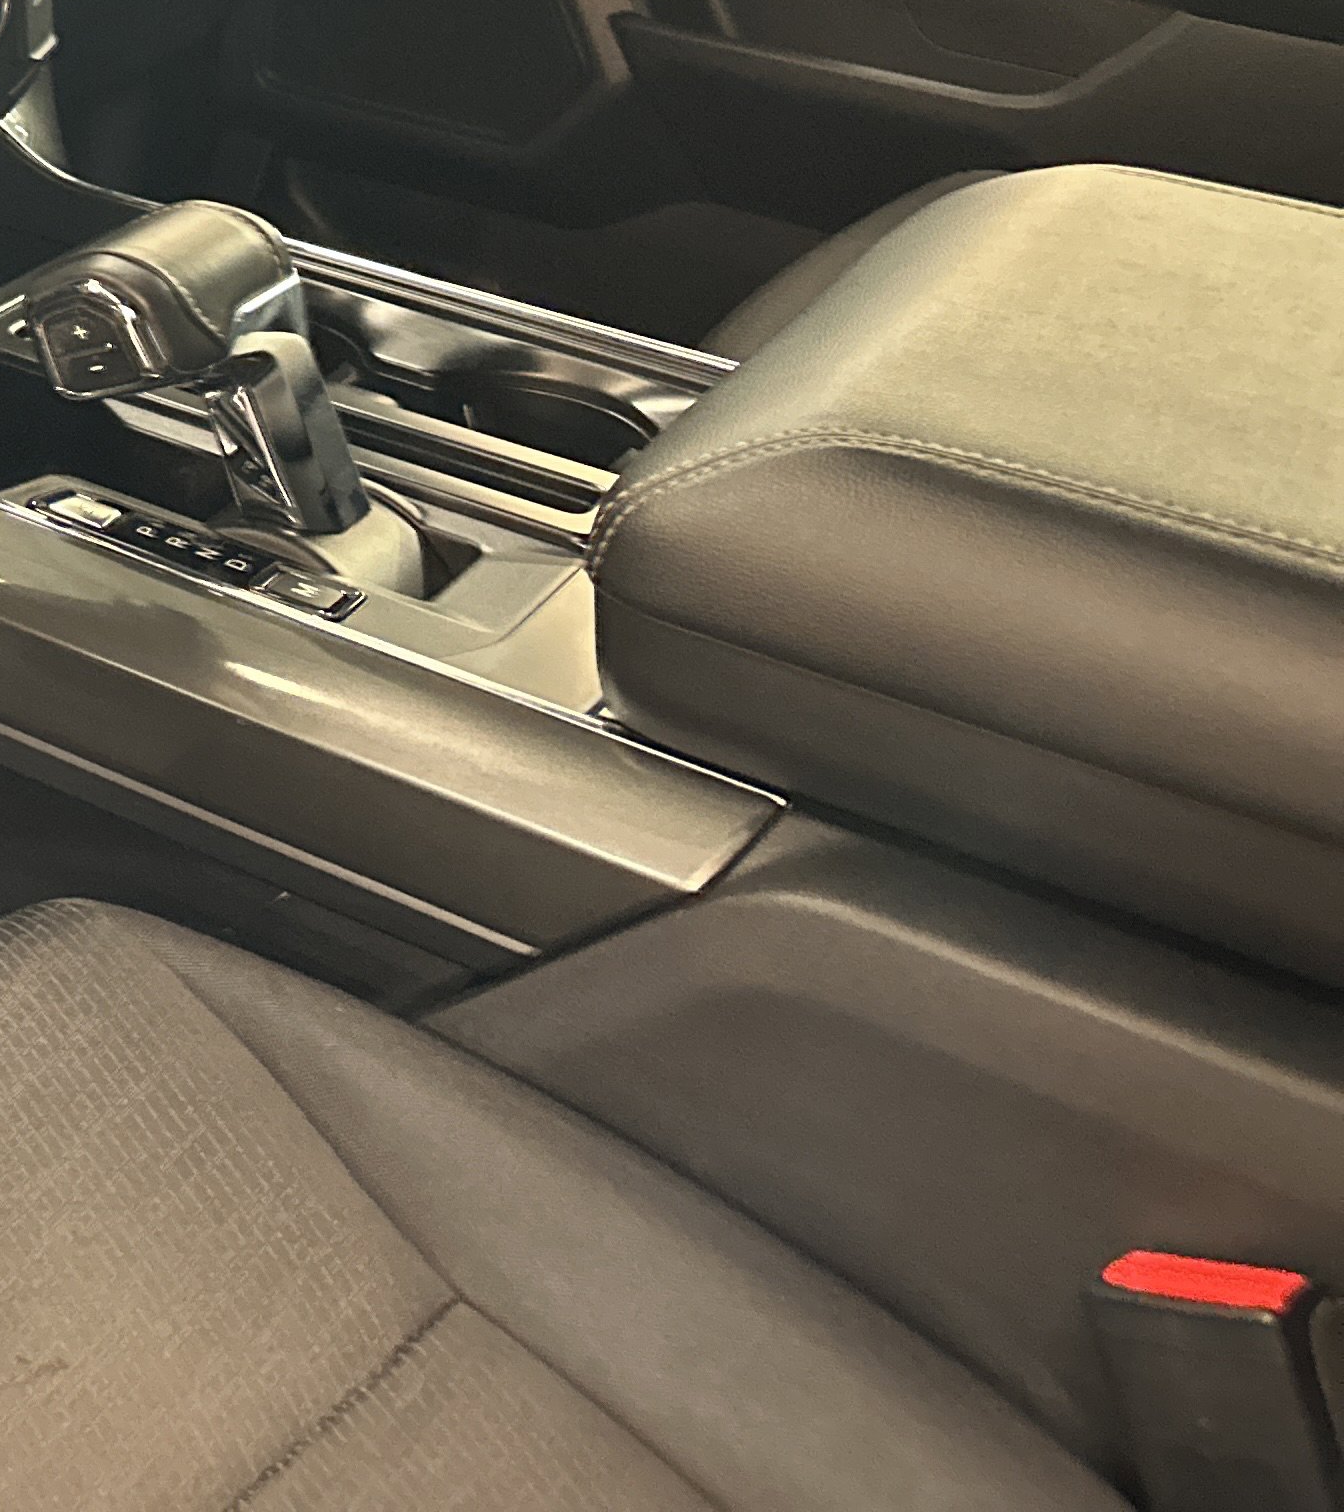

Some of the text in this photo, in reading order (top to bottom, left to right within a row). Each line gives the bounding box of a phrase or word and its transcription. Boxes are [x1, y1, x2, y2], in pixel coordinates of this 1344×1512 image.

[135, 525, 249, 572] P R N D
